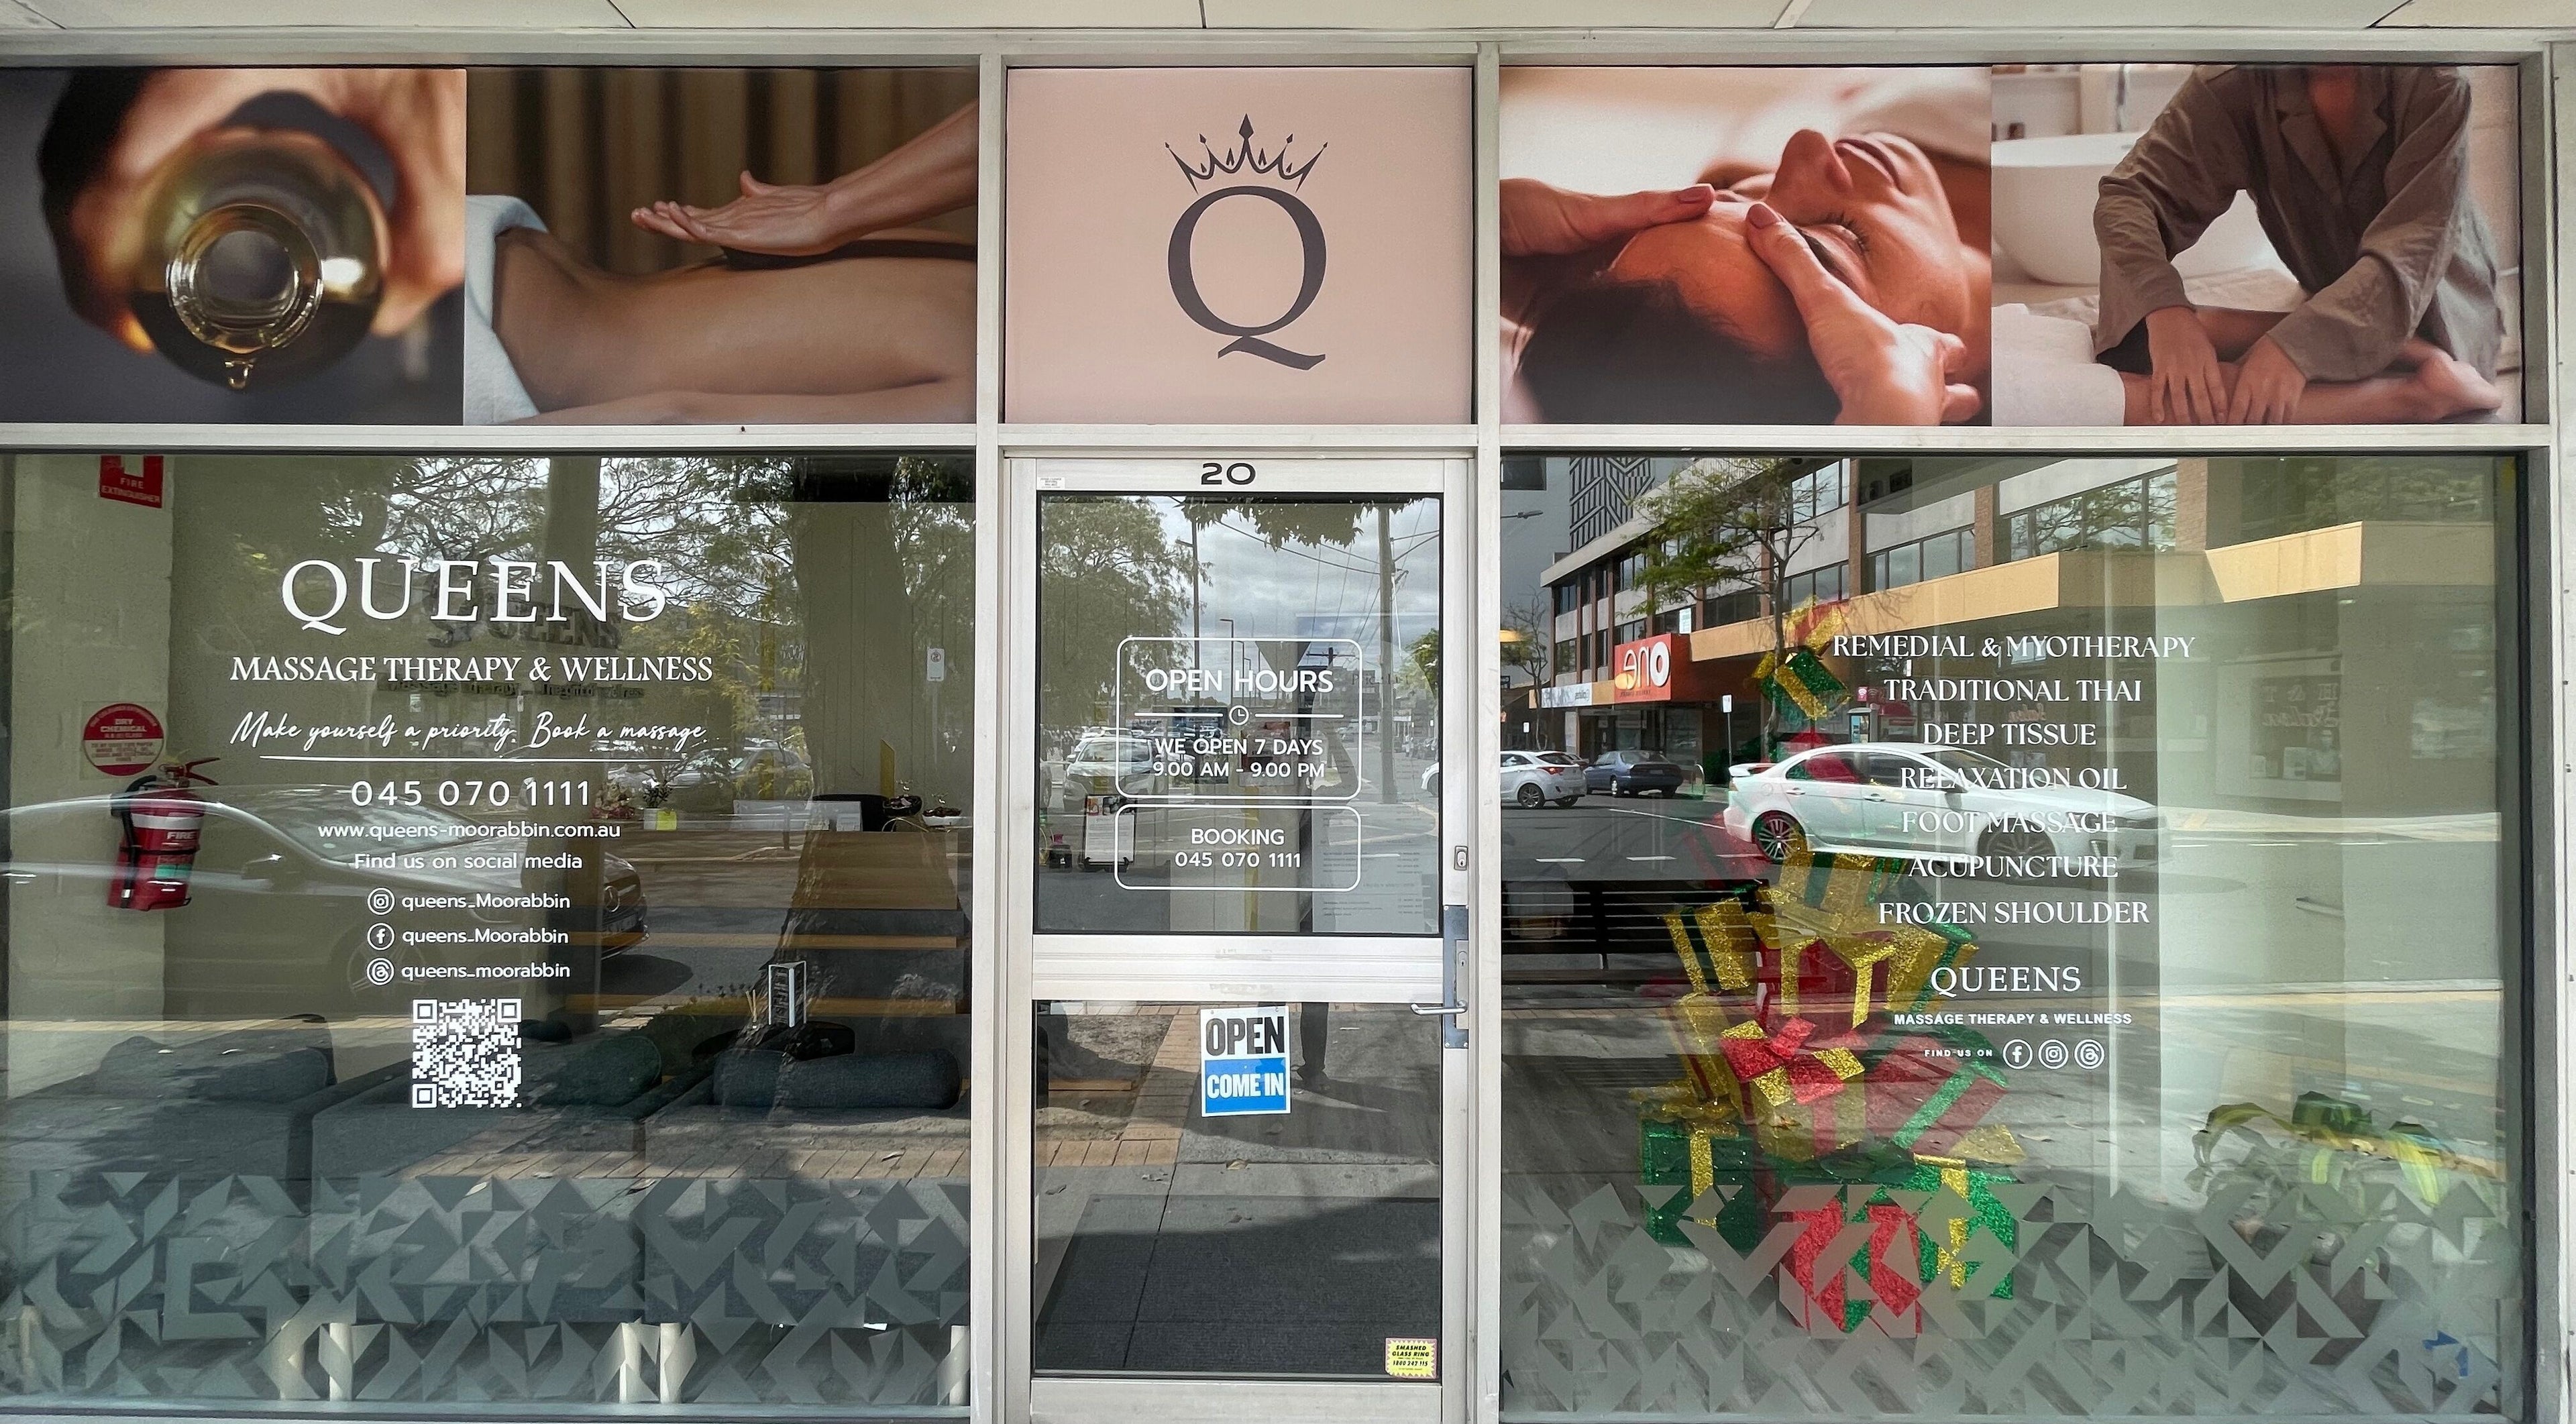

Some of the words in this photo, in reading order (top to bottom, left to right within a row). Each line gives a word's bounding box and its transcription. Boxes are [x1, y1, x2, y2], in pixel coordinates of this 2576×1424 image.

[1168, 185, 1326, 371] Q
[120, 478, 144, 489] FIRE
[1201, 463, 1256, 486] 20
[101, 486, 160, 503] EXTINGUISHER
[281, 557, 667, 636] QUEENS
[1833, 635, 1973, 658] REMEDIAL
[1981, 637, 2000, 658] &
[2006, 636, 2196, 658] MYOTHERAPY
[229, 656, 376, 682] MASSAGE
[383, 656, 522, 682] THERAPY
[530, 657, 551, 682] &
[561, 656, 713, 682] WELLNESS
[1146, 669, 1222, 693] OPEN
[1235, 669, 1334, 693] HOURS
[1884, 679, 2069, 702] TRADITIONAL
[2076, 679, 2141, 702] THAI
[229, 711, 303, 745] Make
[308, 714, 398, 752] yourself
[405, 727, 422, 739] a
[529, 712, 587, 749] Book
[596, 727, 613, 739] a
[619, 724, 707, 753] massage
[1923, 724, 1995, 746] DEEP
[2002, 723, 2096, 746] TISSUE
[1156, 738, 1186, 755] WE
[1194, 738, 1248, 755] OPEN
[1255, 739, 1265, 754] 7
[1273, 738, 1324, 755] DAYS
[1152, 762, 1193, 777] 9.00
[1200, 762, 1229, 777] AM
[1250, 762, 1291, 777] 9.00
[1297, 763, 1325, 778] PM
[1900, 767, 2072, 789] RELAXATION
[2078, 767, 2127, 790] OIL
[350, 779, 422, 807] 045
[439, 779, 509, 807] 070
[527, 781, 590, 806] 1111
[317, 821, 621, 841] www.queens-moorabbin.com.au
[1902, 812, 1980, 834] FOOT
[1986, 812, 2117, 834] MASSAGE
[167, 832, 195, 840] FIRE
[1191, 828, 1285, 845] BOOKING
[354, 853, 396, 869] Find
[403, 857, 425, 869] us
[433, 857, 456, 869] on
[464, 854, 517, 869] social
[525, 854, 583, 869] media
[1175, 852, 1212, 867] 045
[1222, 852, 1260, 868] 070
[1270, 853, 1301, 867] 1111
[1909, 856, 2118, 878] ACUPUNCTURE
[402, 893, 570, 912] queens_Moorabbin
[1878, 901, 1987, 924] FROZEN
[1994, 901, 2150, 924] SHOULDER
[402, 928, 569, 946] queens_Moorabbin
[402, 963, 570, 981] queens_moorabbin
[1931, 966, 2082, 998] QUEENS
[1894, 1014, 1964, 1026] MASSAGE
[1968, 1014, 2035, 1026] THERAPY
[2039, 1014, 2049, 1025] &
[2054, 1013, 2132, 1026] WELLNESS
[1205, 1016, 1284, 1055] OPEN
[1924, 1049, 1951, 1057] FIND
[1958, 1050, 1972, 1058] US
[1977, 1049, 1993, 1057] ON
[1207, 1073, 1260, 1098] COME
[1265, 1073, 1284, 1096] IN
